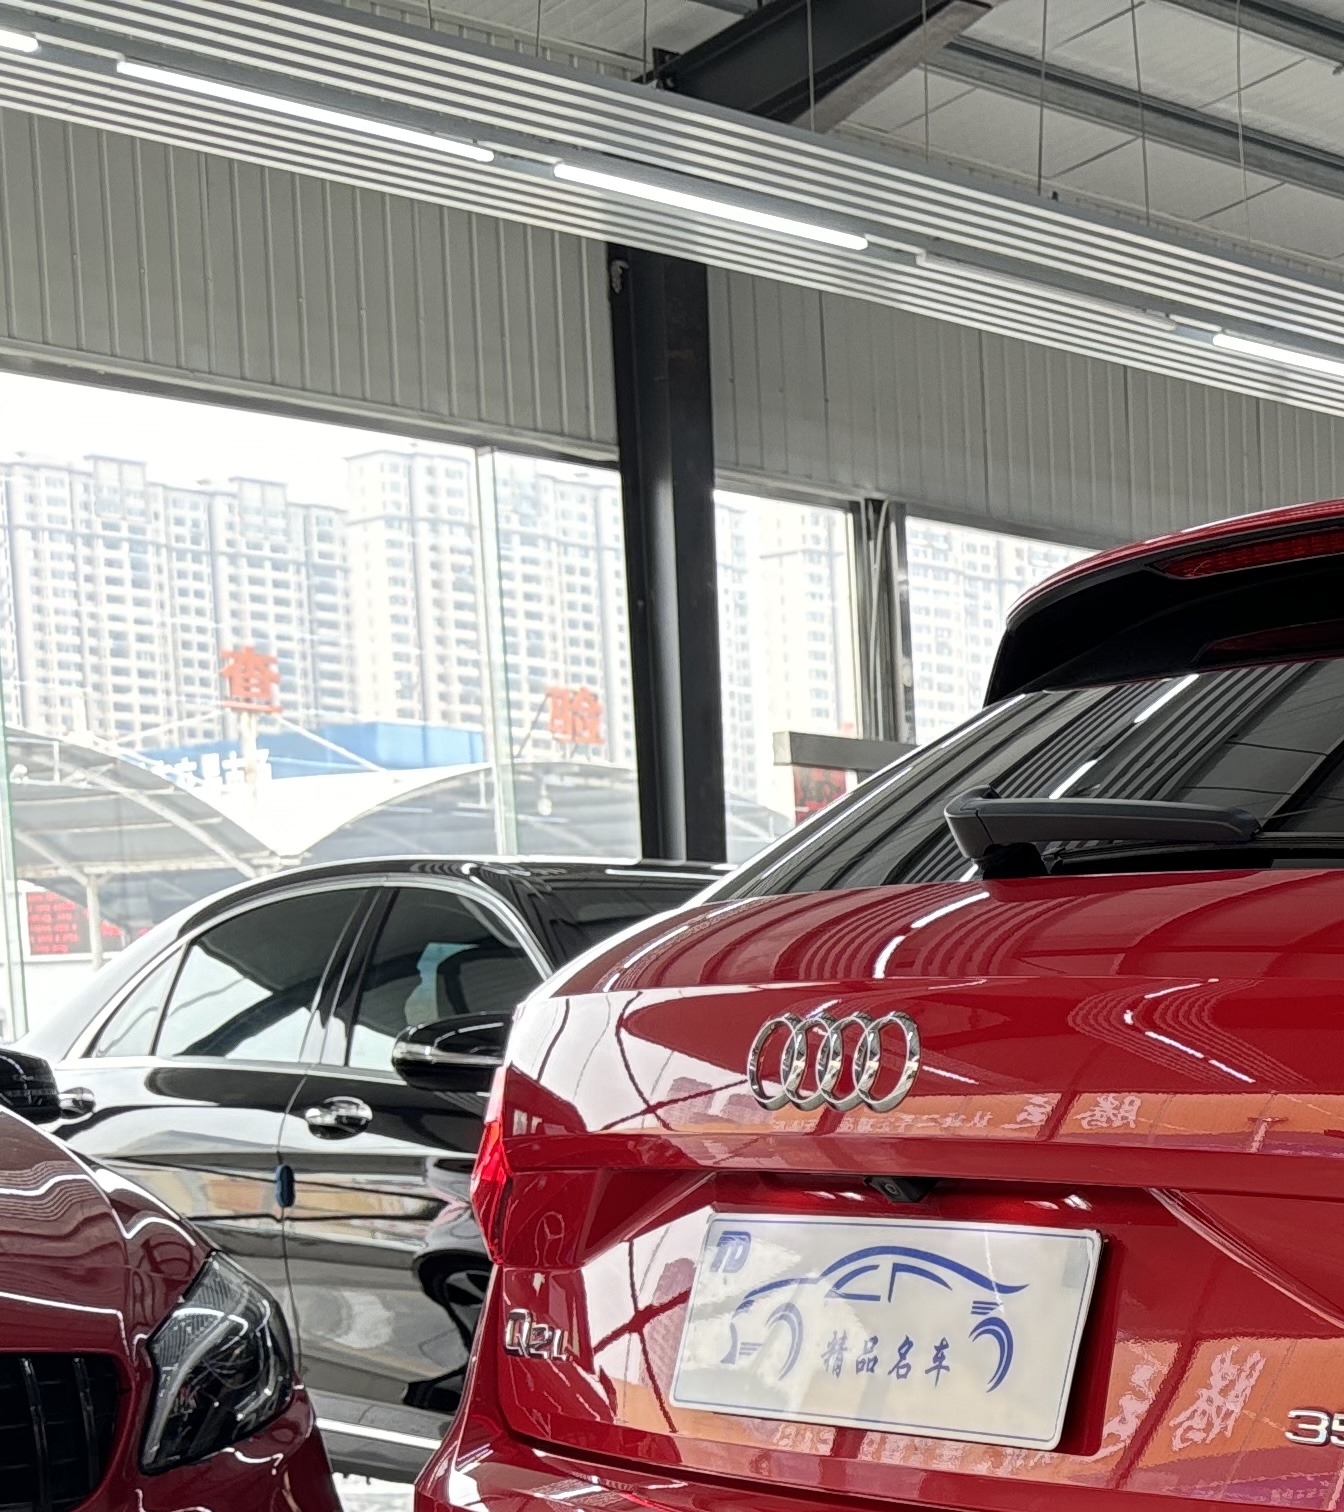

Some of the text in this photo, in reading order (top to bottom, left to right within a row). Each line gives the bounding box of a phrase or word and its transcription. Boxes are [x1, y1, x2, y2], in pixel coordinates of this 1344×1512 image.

[504, 1308, 568, 1361] Q2L
[820, 1329, 951, 1388] 精品名车
